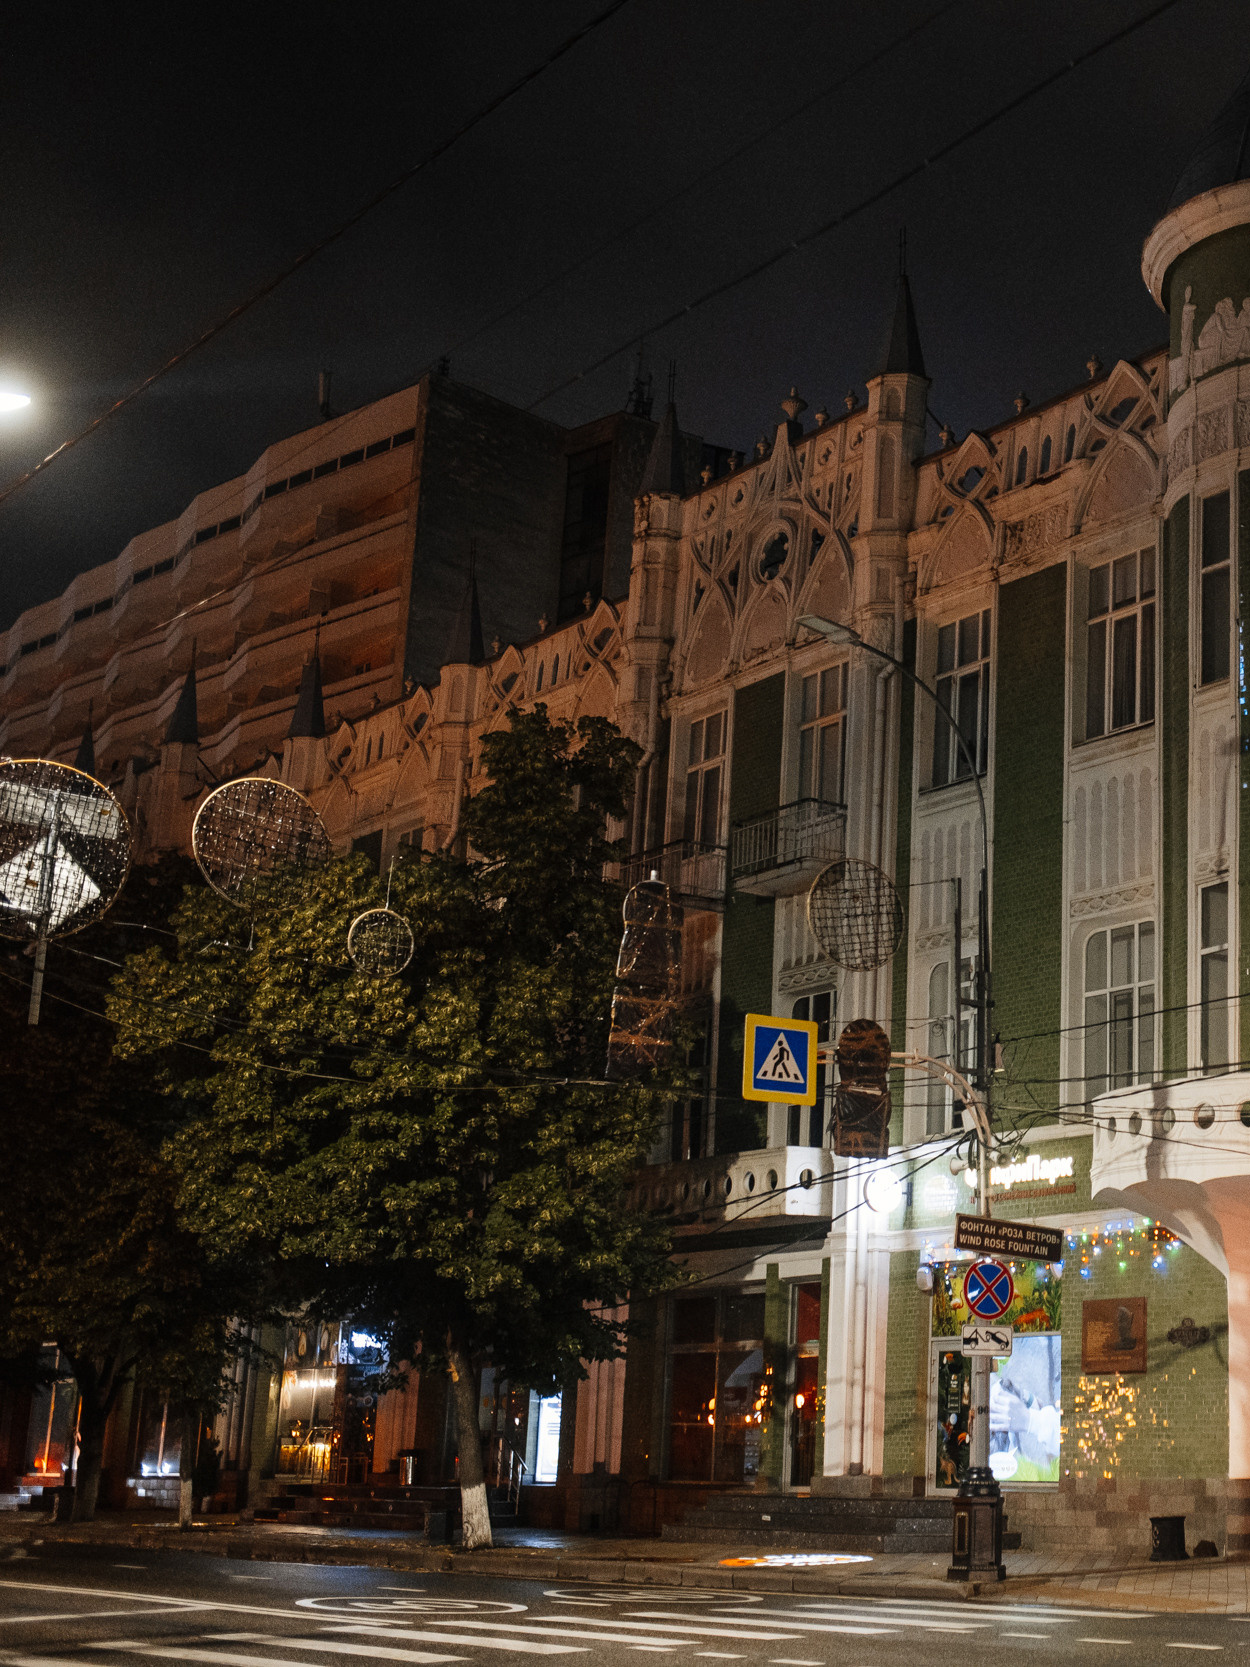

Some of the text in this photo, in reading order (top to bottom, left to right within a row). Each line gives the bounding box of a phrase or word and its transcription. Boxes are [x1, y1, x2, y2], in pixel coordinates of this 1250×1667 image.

[960, 1221, 1060, 1244] ФОНТАН «РОЗА ВЕТРОВ»
[959, 1234, 1049, 1256] WIND ROSE FOUNTAIN
